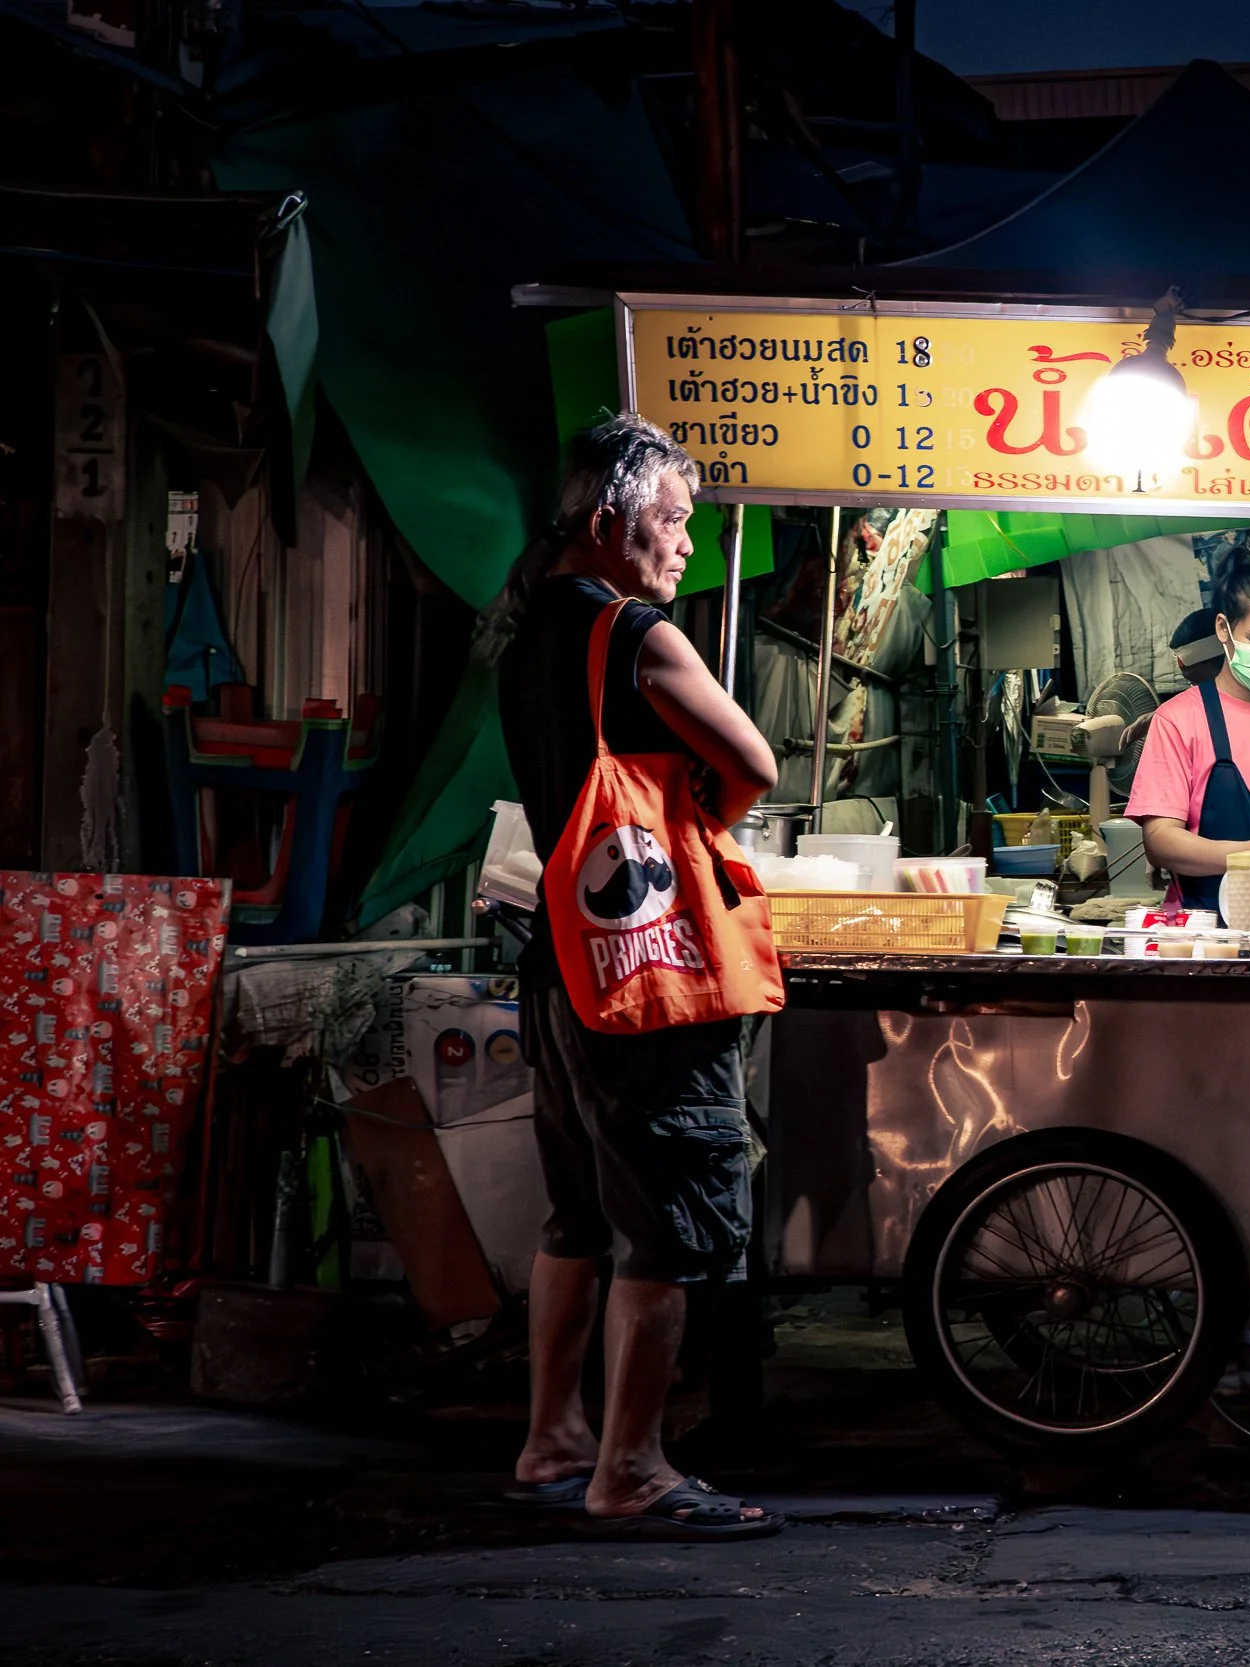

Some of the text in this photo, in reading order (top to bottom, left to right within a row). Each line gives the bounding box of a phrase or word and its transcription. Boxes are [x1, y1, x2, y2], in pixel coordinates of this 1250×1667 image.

[667, 327, 868, 363] เต้าฮวยนมสด
[896, 336, 934, 367] 18
[668, 366, 878, 406] เต้าฮวย+น้ำขิง
[669, 411, 779, 447] ชาเขียว
[896, 426, 934, 450] 12
[694, 451, 748, 483] าดำ
[973, 471, 1123, 493] ธรรมดา
[589, 918, 705, 990] PRINGLES
